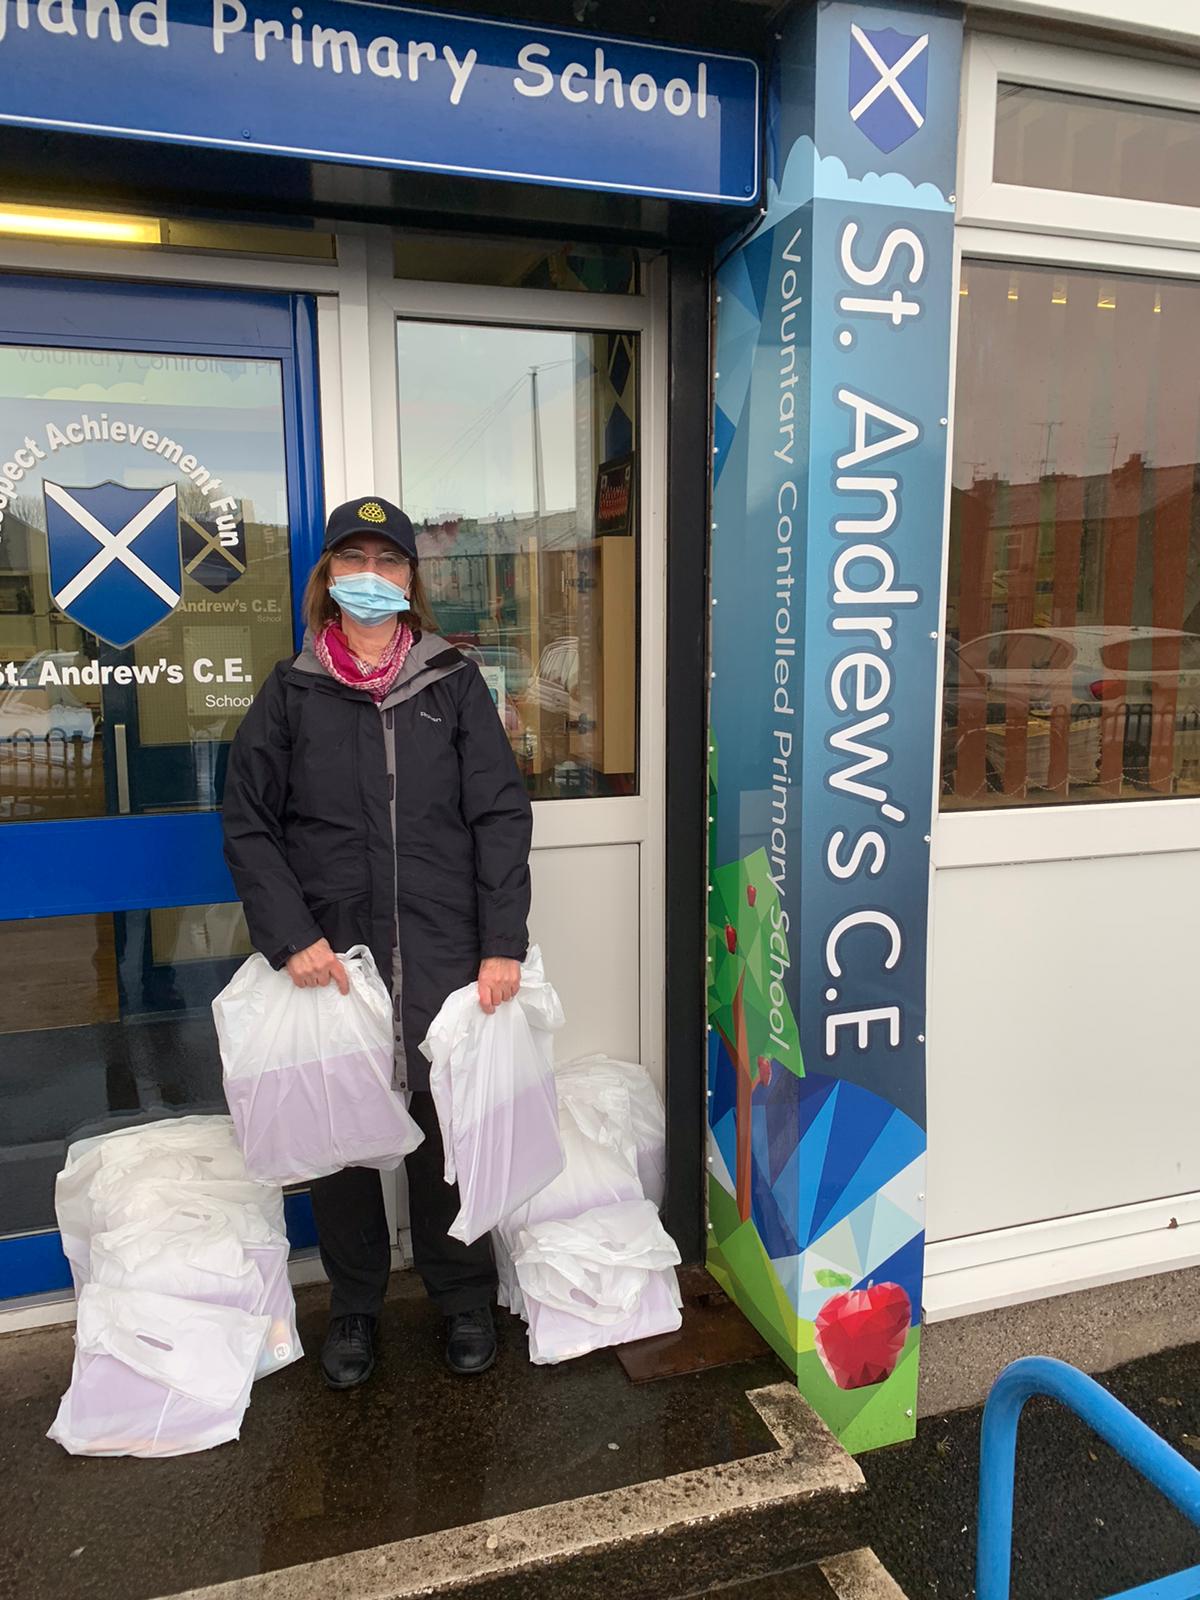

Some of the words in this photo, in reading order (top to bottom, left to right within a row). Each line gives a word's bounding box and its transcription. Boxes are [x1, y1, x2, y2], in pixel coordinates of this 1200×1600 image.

[0, 0, 168, 47] land
[213, 0, 476, 104] Primary
[513, 43, 706, 118] School
[773, 228, 802, 464] Voluntary
[840, 222, 924, 346] St.
[45, 413, 223, 496] Achievement
[209, 495, 240, 547] Fun
[177, 599, 247, 613] Andrew's
[252, 600, 281, 612] C.E.
[773, 481, 798, 714] Controlled
[828, 389, 919, 879] Andrew's
[38, 658, 184, 686] Andrew's
[193, 658, 252, 683] C.E.
[205, 694, 254, 707] School
[766, 731, 793, 897] Primary
[768, 906, 791, 1050] School
[825, 910, 900, 1056] C.E
